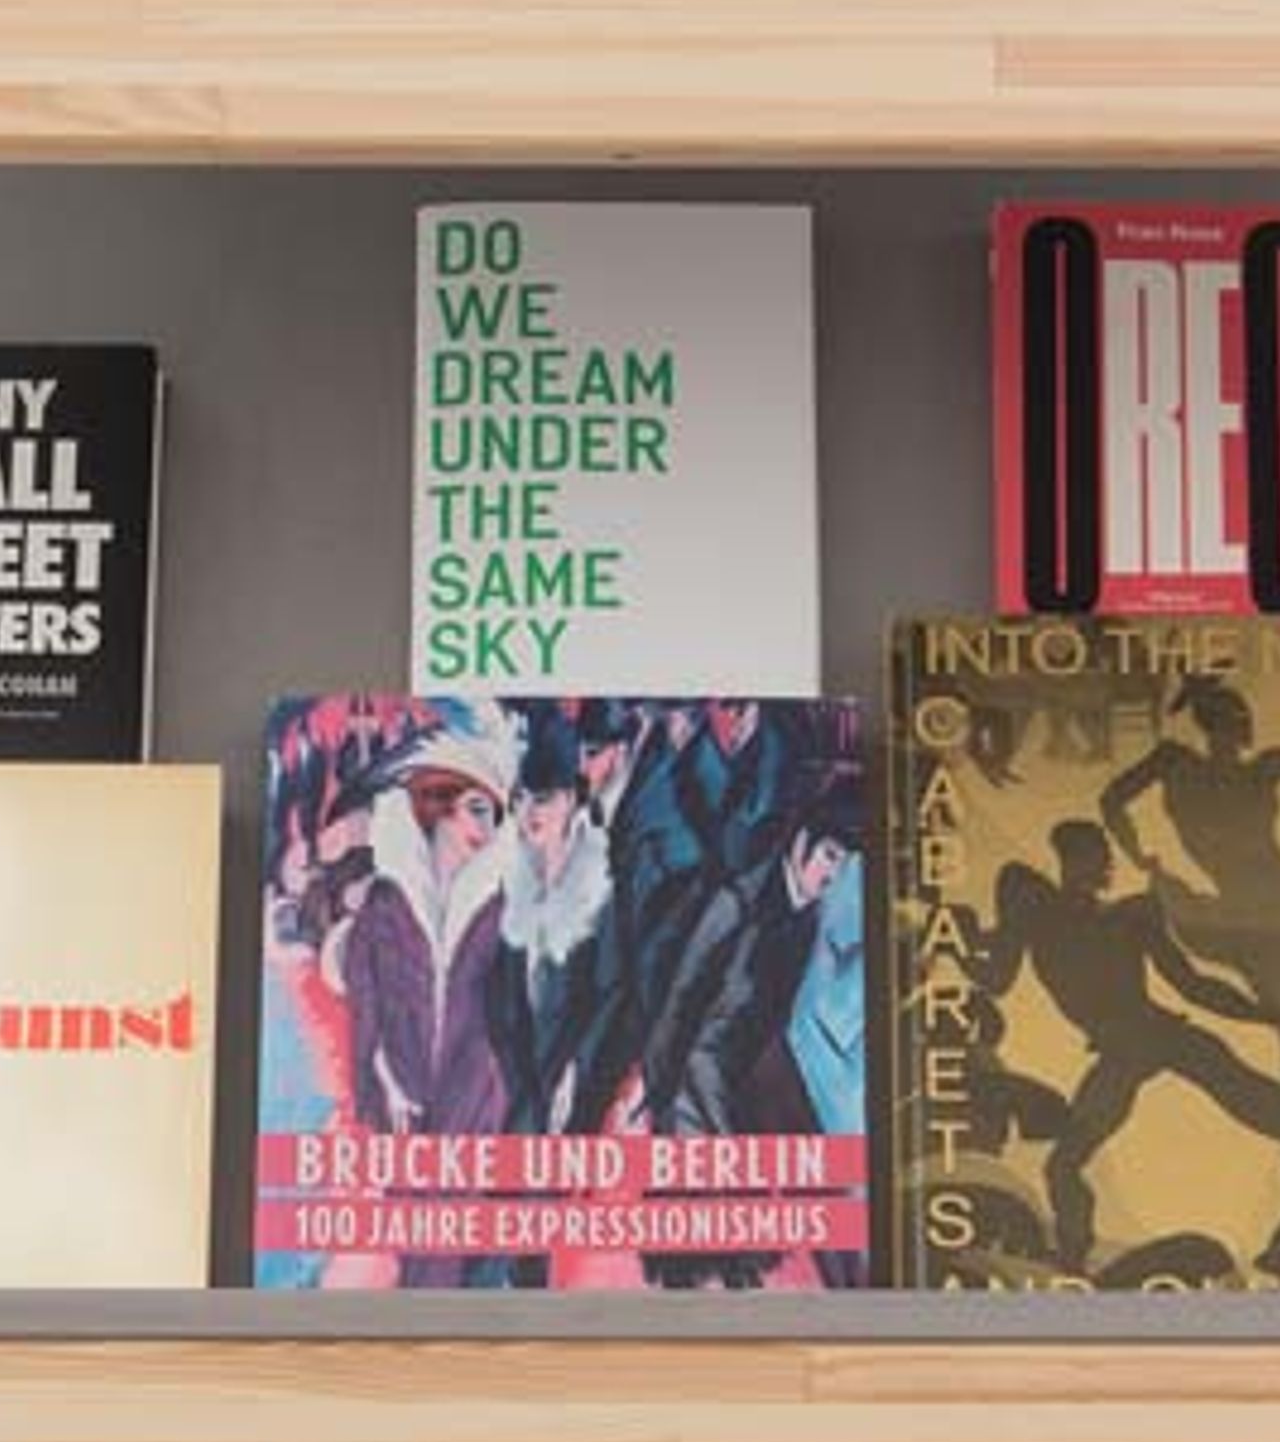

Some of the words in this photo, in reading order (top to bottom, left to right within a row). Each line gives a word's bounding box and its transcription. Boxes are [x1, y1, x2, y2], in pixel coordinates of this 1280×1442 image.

[436, 219, 522, 276] DO
[436, 283, 558, 341] WE
[432, 349, 674, 407] DREAM
[431, 415, 669, 473] UNDER
[428, 483, 559, 542] THE
[428, 551, 622, 612] SAME
[428, 618, 568, 680] SKY
[925, 628, 1086, 676] INTO
[1102, 628, 1240, 676] THE
[522, 1136, 627, 1189] UND
[650, 1137, 827, 1189] BERLIN
[295, 1205, 356, 1248] 100
[366, 1206, 482, 1248] JAHRE
[495, 1205, 830, 1247] EXPRESSIONISMUS
